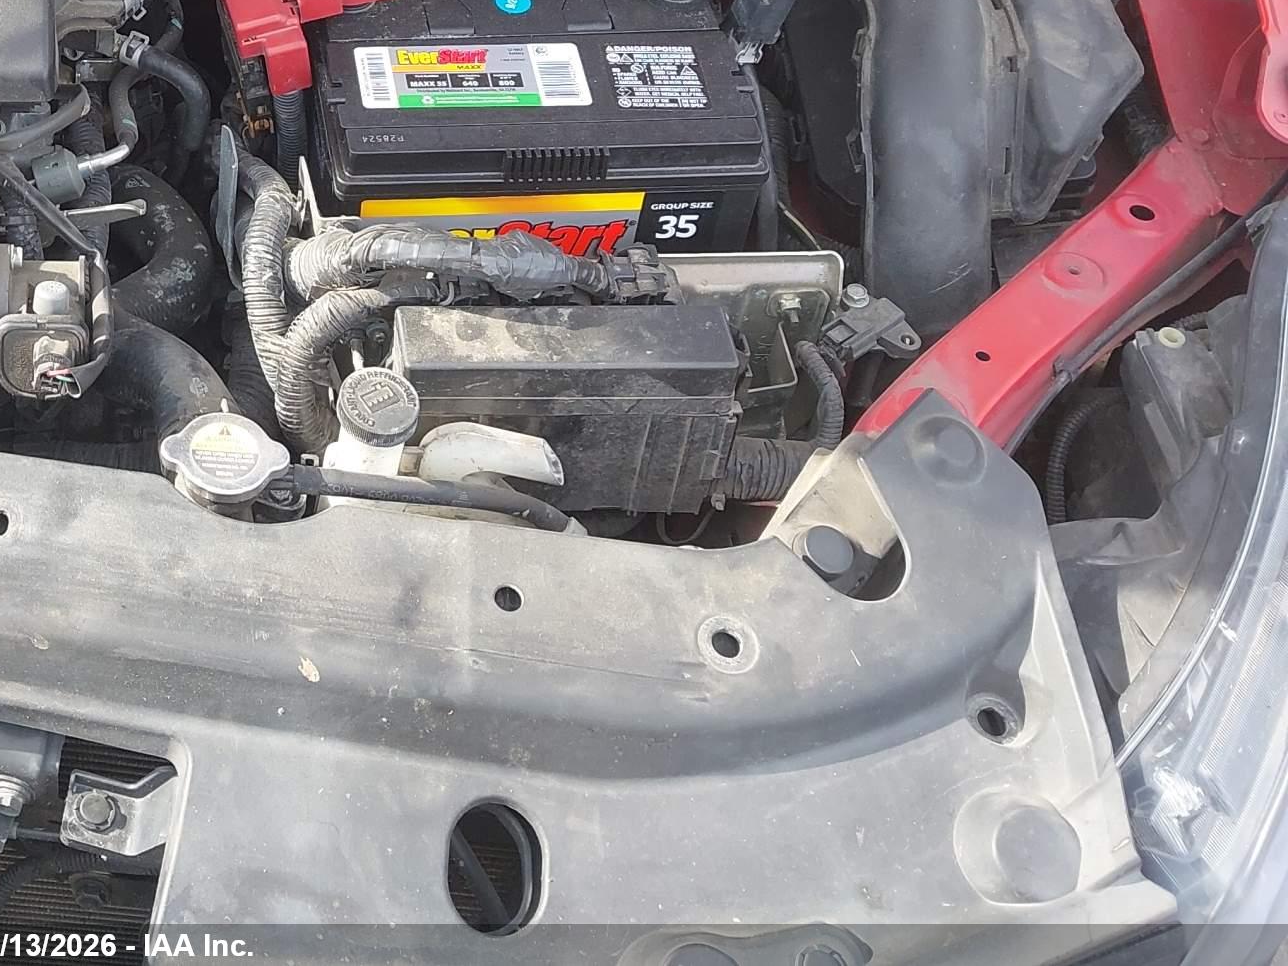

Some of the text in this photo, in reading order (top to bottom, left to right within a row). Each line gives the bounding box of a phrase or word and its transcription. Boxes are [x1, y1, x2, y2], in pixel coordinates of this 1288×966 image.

[397, 49, 487, 65] EverStart
[651, 201, 714, 211] GROUP SIZE
[655, 215, 700, 239] 35
